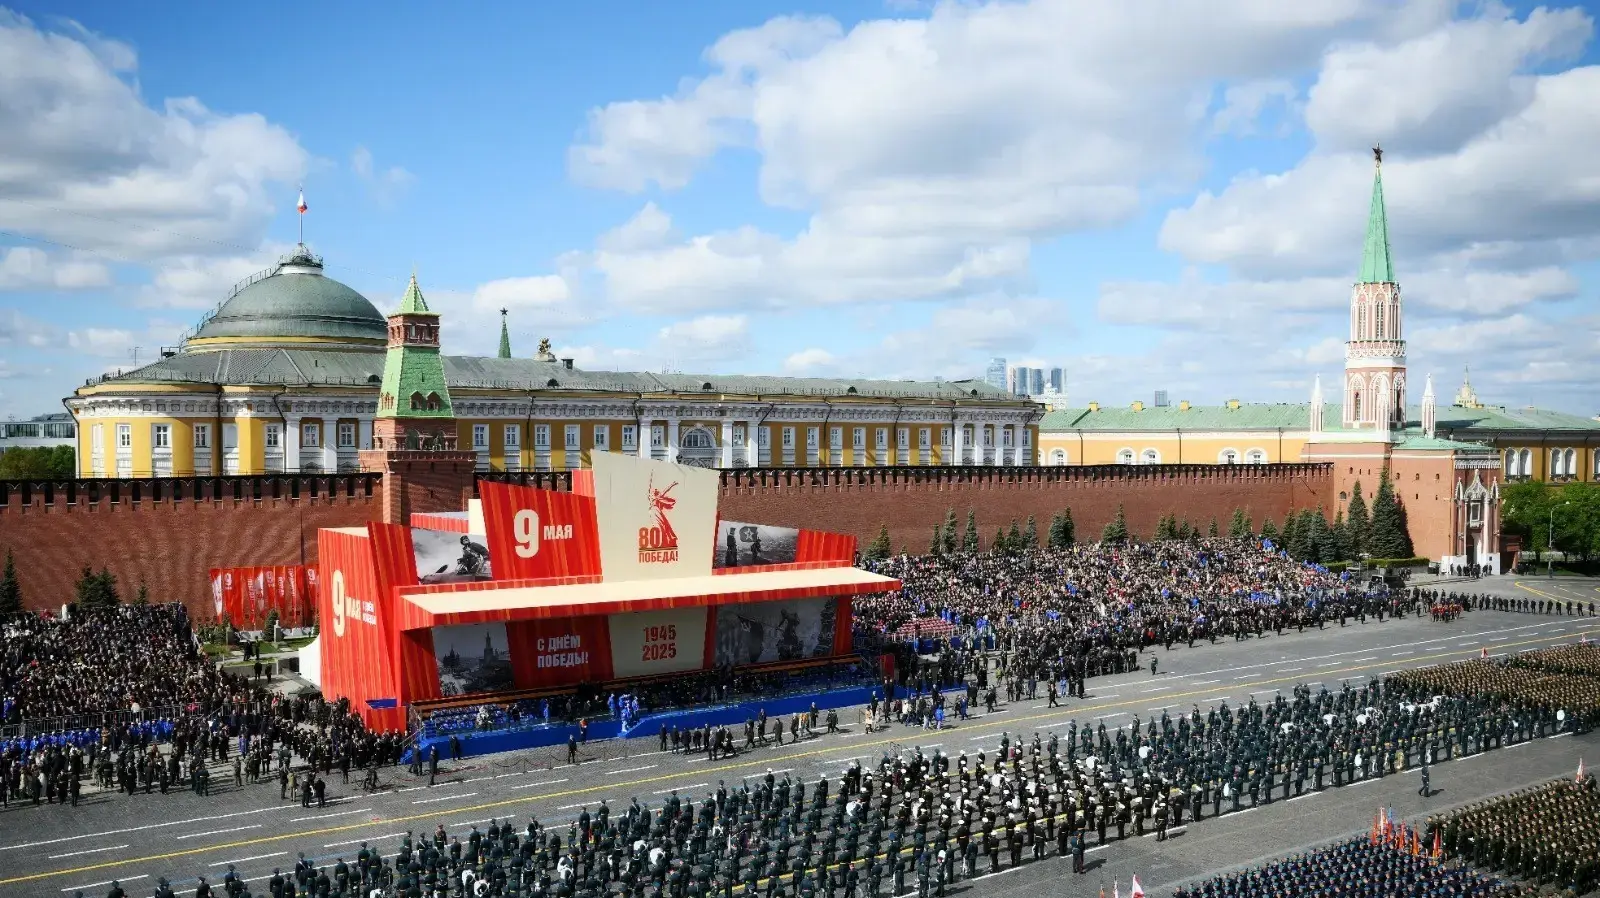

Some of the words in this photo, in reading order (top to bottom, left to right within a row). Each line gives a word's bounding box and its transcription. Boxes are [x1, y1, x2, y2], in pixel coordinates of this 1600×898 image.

[514, 509, 539, 558] 9
[544, 525, 573, 541] МАЯ
[639, 527, 661, 548] 80
[639, 551, 678, 563] ПОБЕДА!
[332, 569, 345, 637] 9
[538, 639, 544, 651] С
[548, 634, 580, 652] ДНЁМ
[643, 625, 676, 643] 1945
[538, 652, 588, 667] ПОБЕДЫ!
[642, 643, 677, 661] 2025
